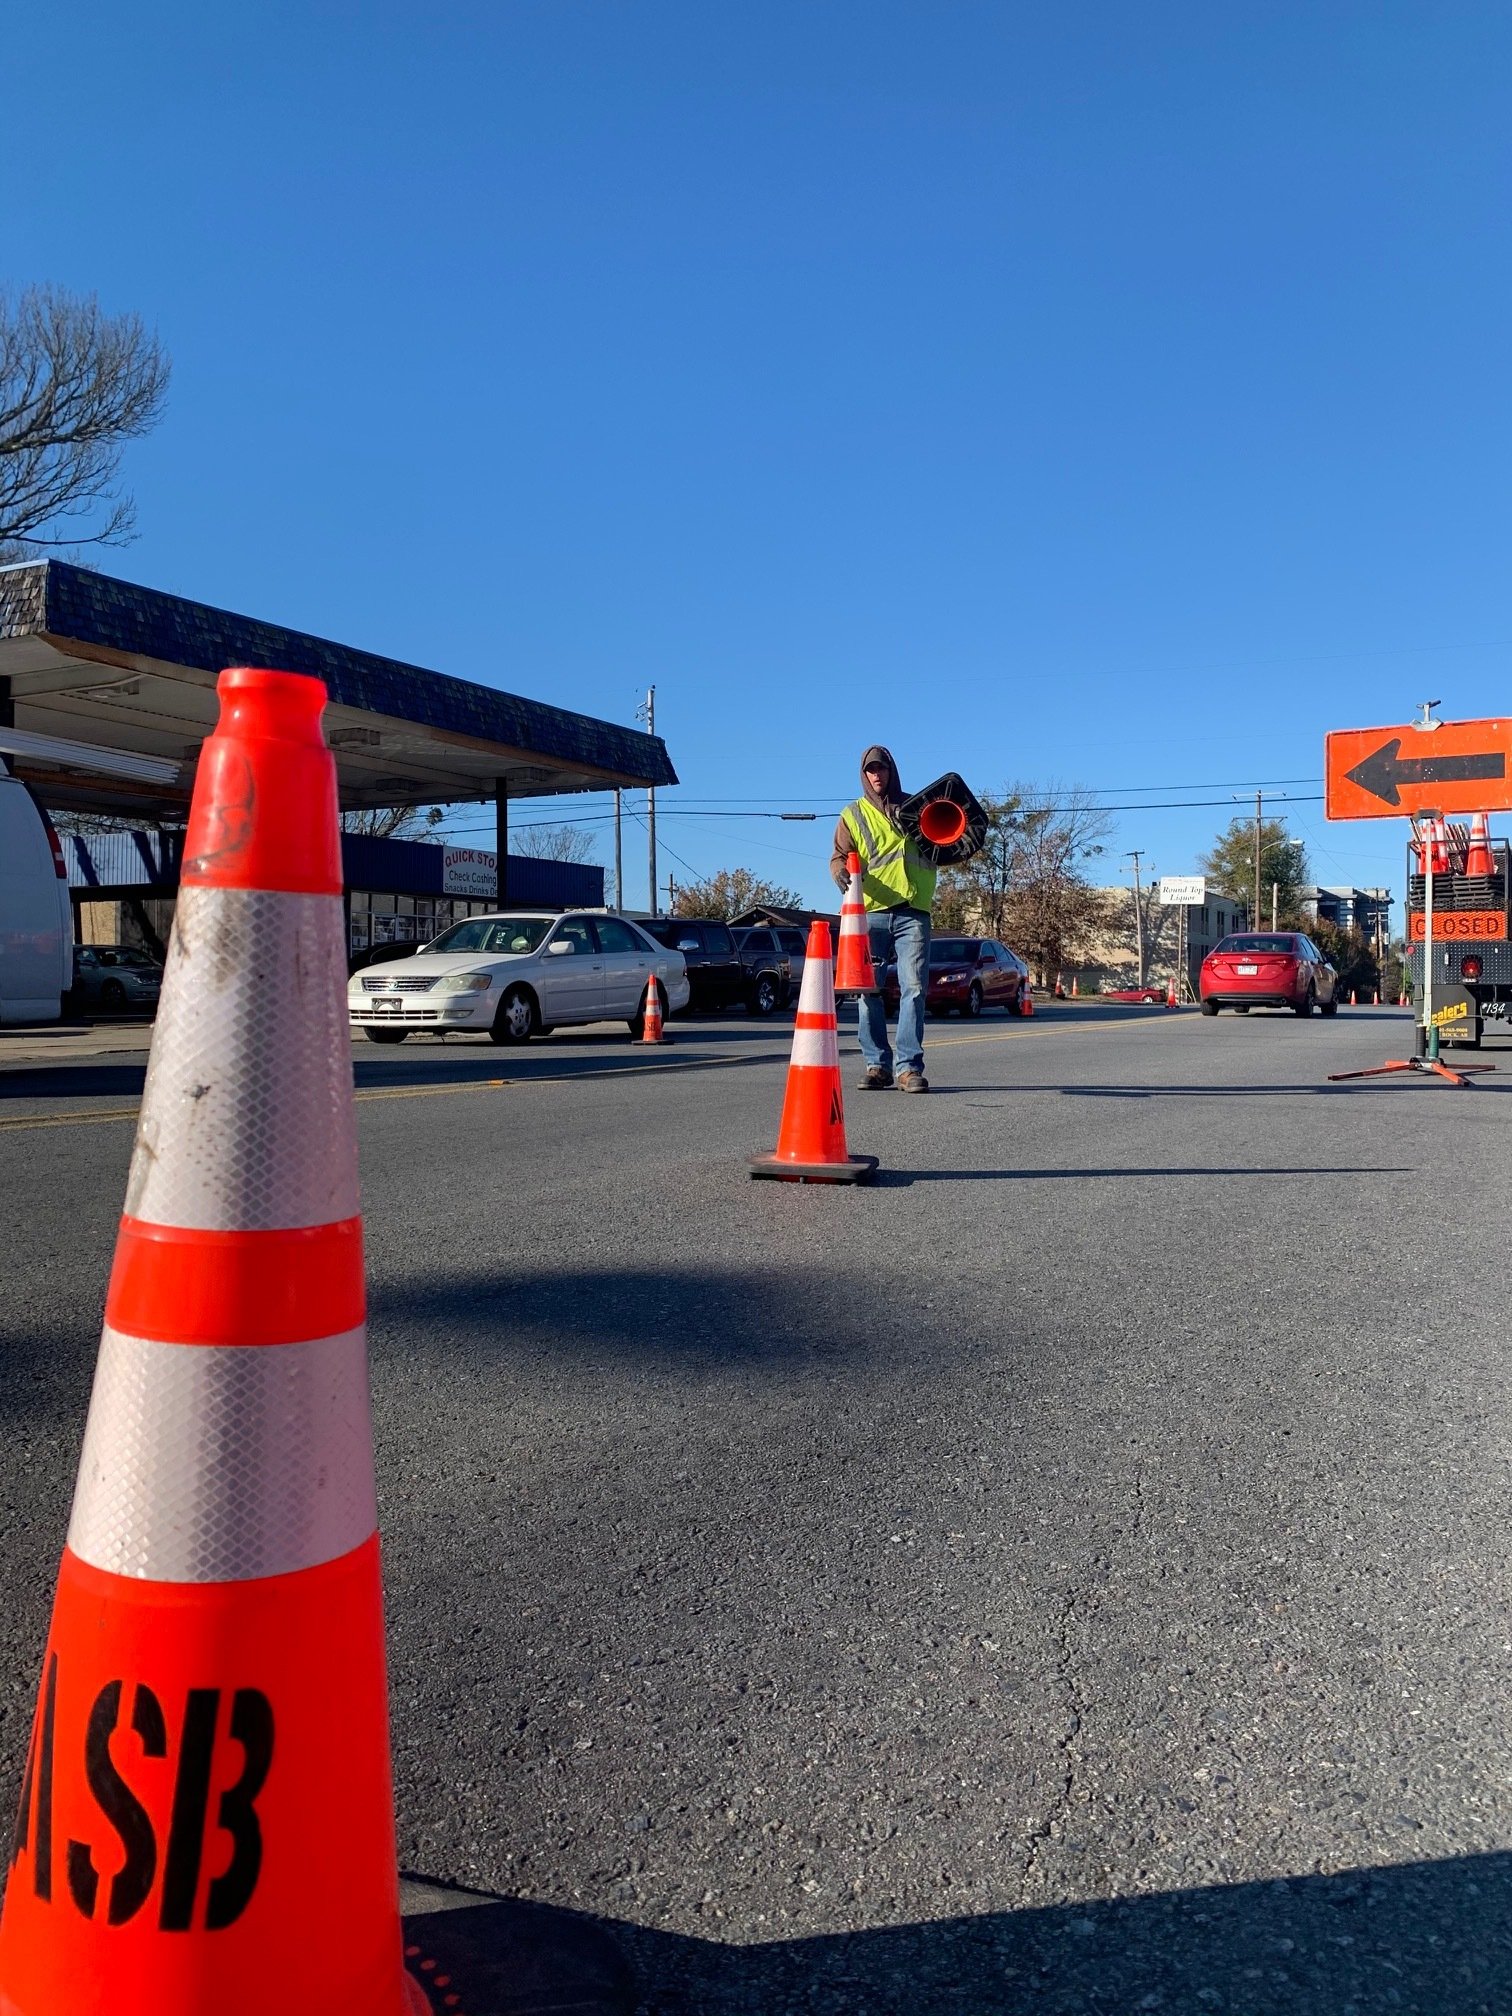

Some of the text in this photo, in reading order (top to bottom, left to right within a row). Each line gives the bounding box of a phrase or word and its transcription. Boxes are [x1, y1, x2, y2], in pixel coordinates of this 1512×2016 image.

[445, 851, 497, 872] QUICK STO
[449, 870, 497, 887] Check Cashing
[445, 883, 467, 893] Snacks
[469, 886, 488, 895] Drinks
[1190, 886, 1203, 895] Top
[1170, 894, 1195, 902] Liquor
[1415, 918, 1499, 935] CLOSED
[1431, 1002, 1467, 1025] ealers
